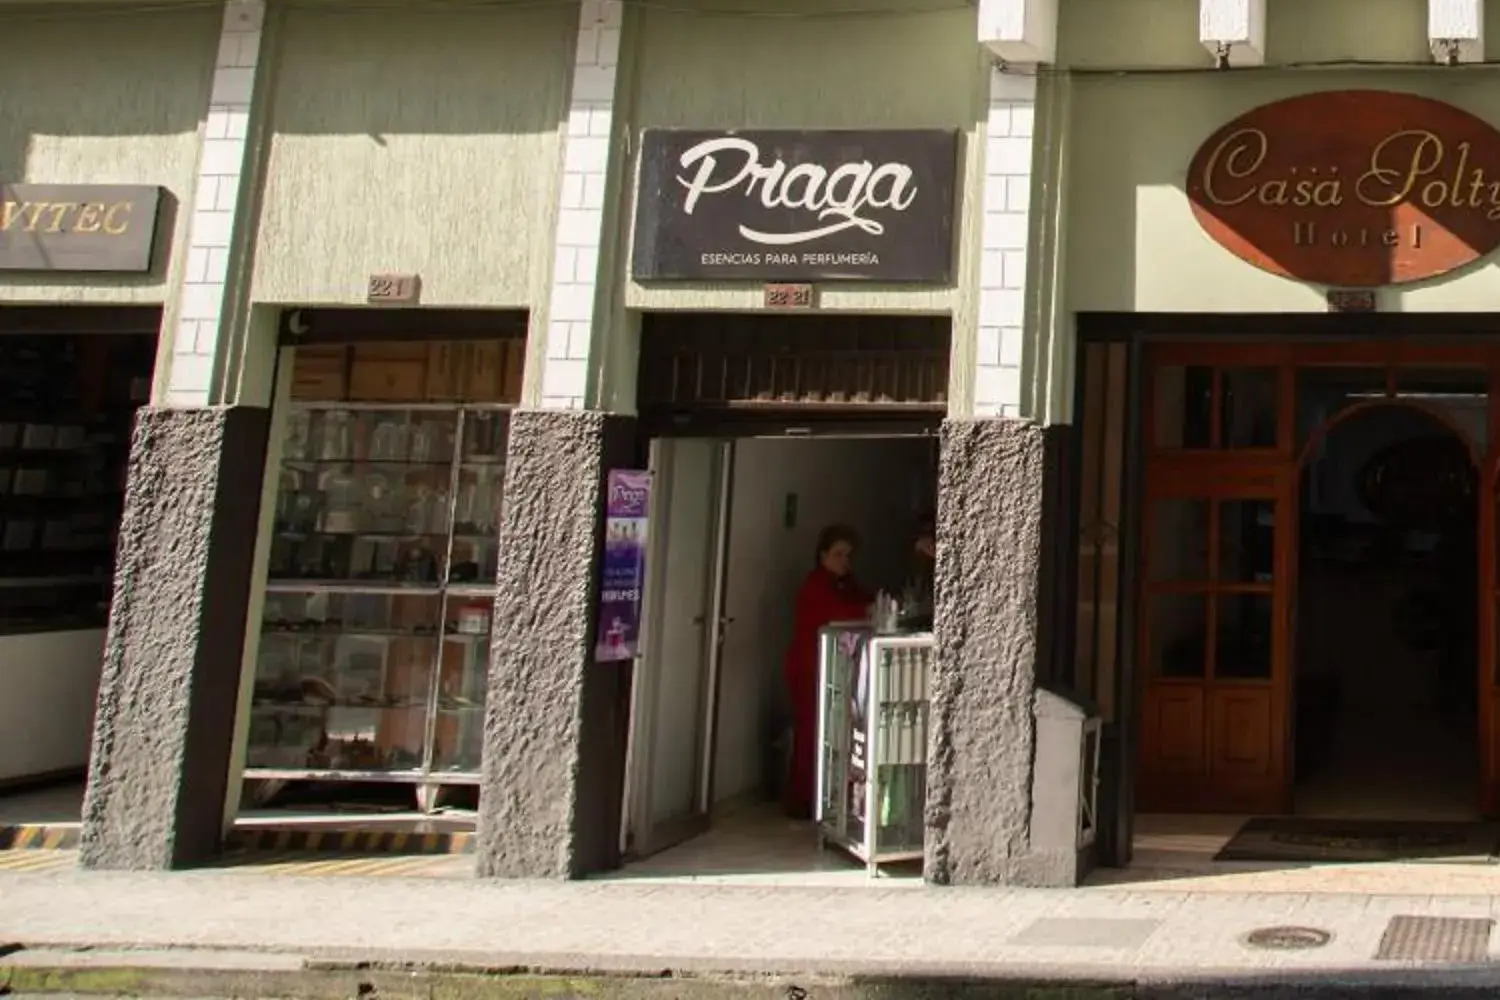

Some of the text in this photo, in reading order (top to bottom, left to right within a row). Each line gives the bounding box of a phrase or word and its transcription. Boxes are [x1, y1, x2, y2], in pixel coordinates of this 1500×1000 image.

[676, 137, 918, 244] Praga
[1203, 129, 1343, 205] Casa
[701, 251, 879, 265] ESENCIAS PARA PERFUMERÍA
[1292, 222, 1423, 249] Hotel
